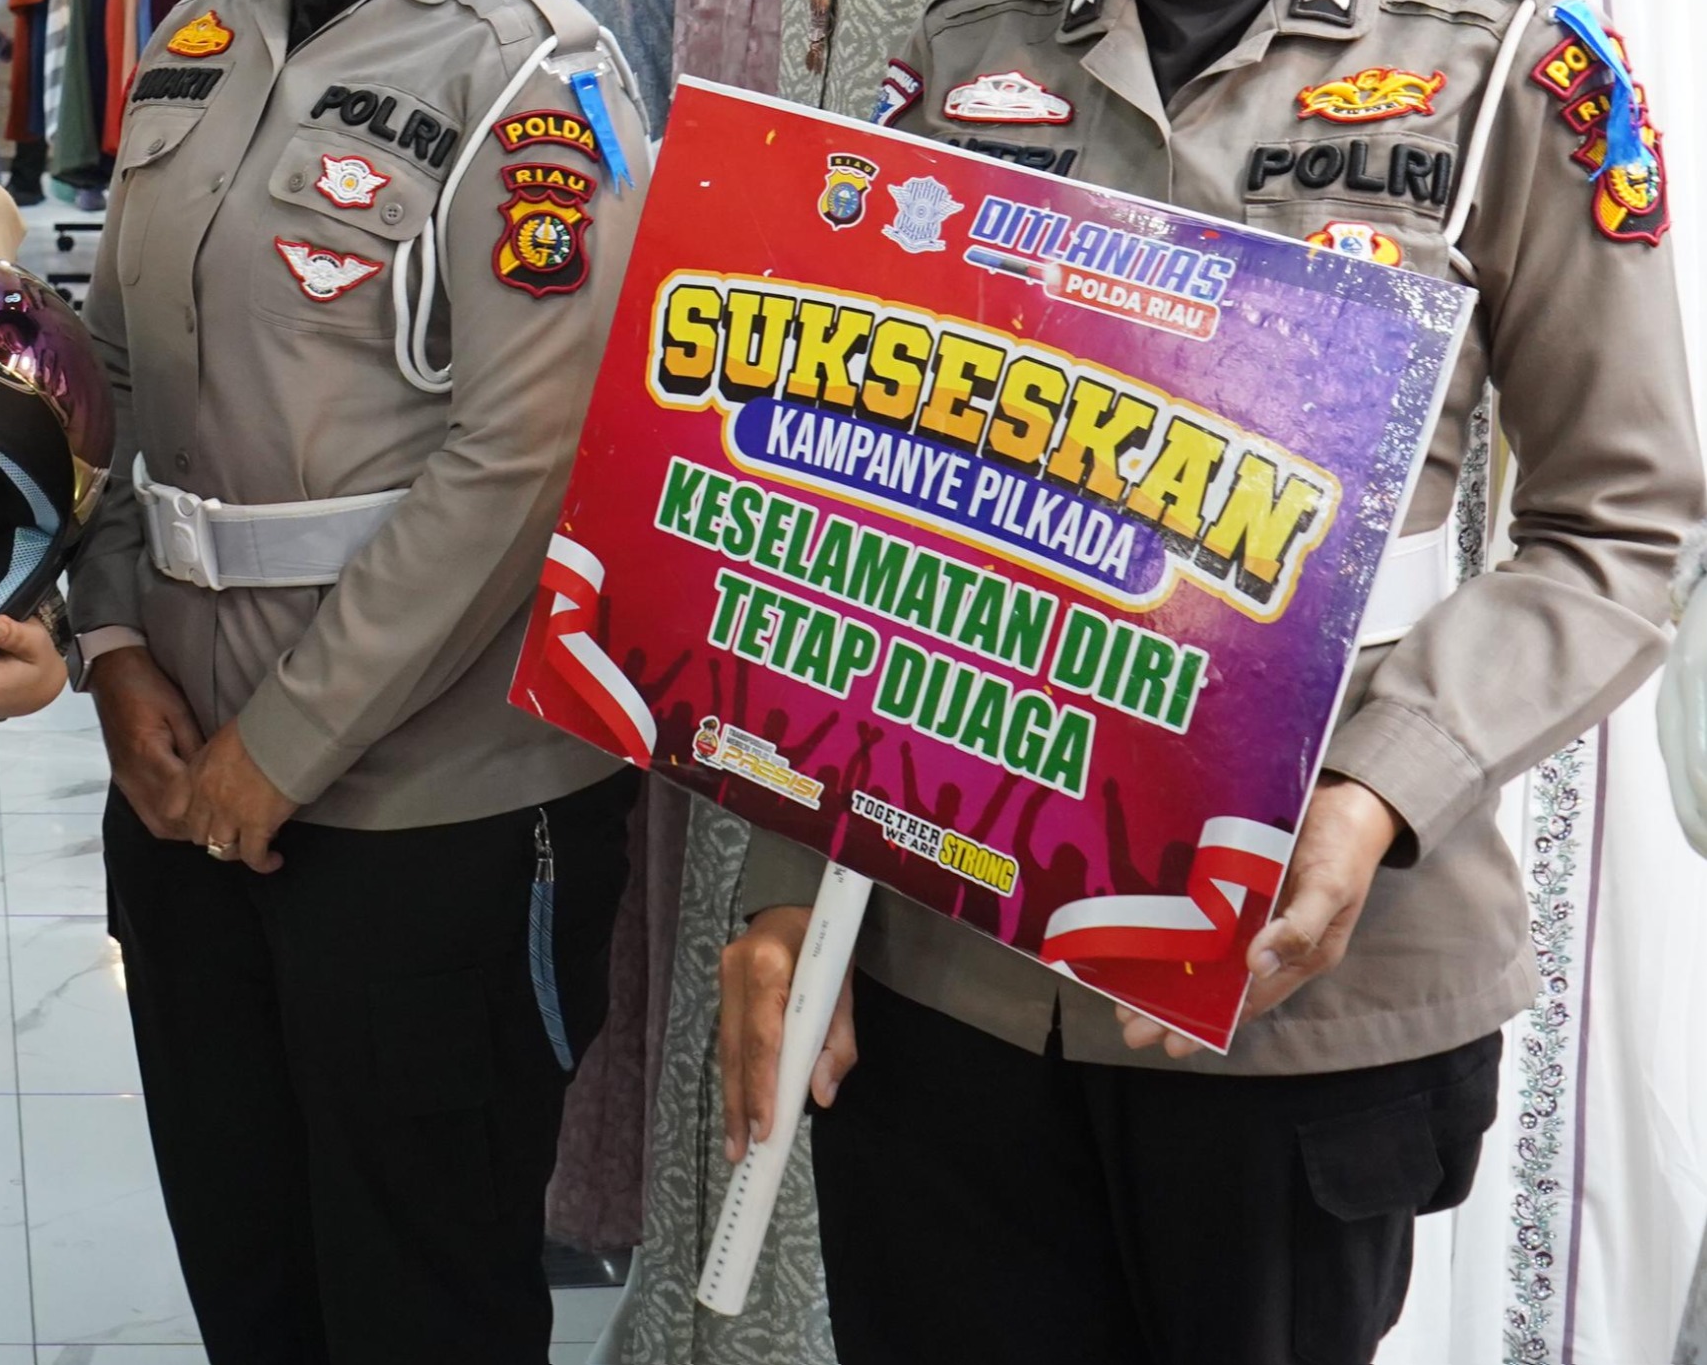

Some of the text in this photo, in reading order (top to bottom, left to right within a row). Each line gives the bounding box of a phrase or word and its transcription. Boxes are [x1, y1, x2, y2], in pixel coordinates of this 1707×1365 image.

[310, 84, 457, 168] POLRI
[506, 117, 594, 149] POLDA
[515, 169, 585, 191] RIAU
[834, 157, 872, 174] RIAU
[1247, 138, 1451, 205] POLRI
[970, 197, 1236, 303] DITLANTAS
[1066, 273, 1204, 329] POLDA RIAU
[660, 285, 1318, 602] SUKSESKAN
[767, 404, 1139, 582] KAMPANYE PILKADA
[654, 456, 1209, 733] KESELAMATAN DIRI
[708, 571, 1096, 799] TETAP DIJAGA
[721, 745, 822, 800] PRESISI
[854, 794, 941, 845] TOGETHER
[885, 826, 1016, 893] WE ARE STRONG
